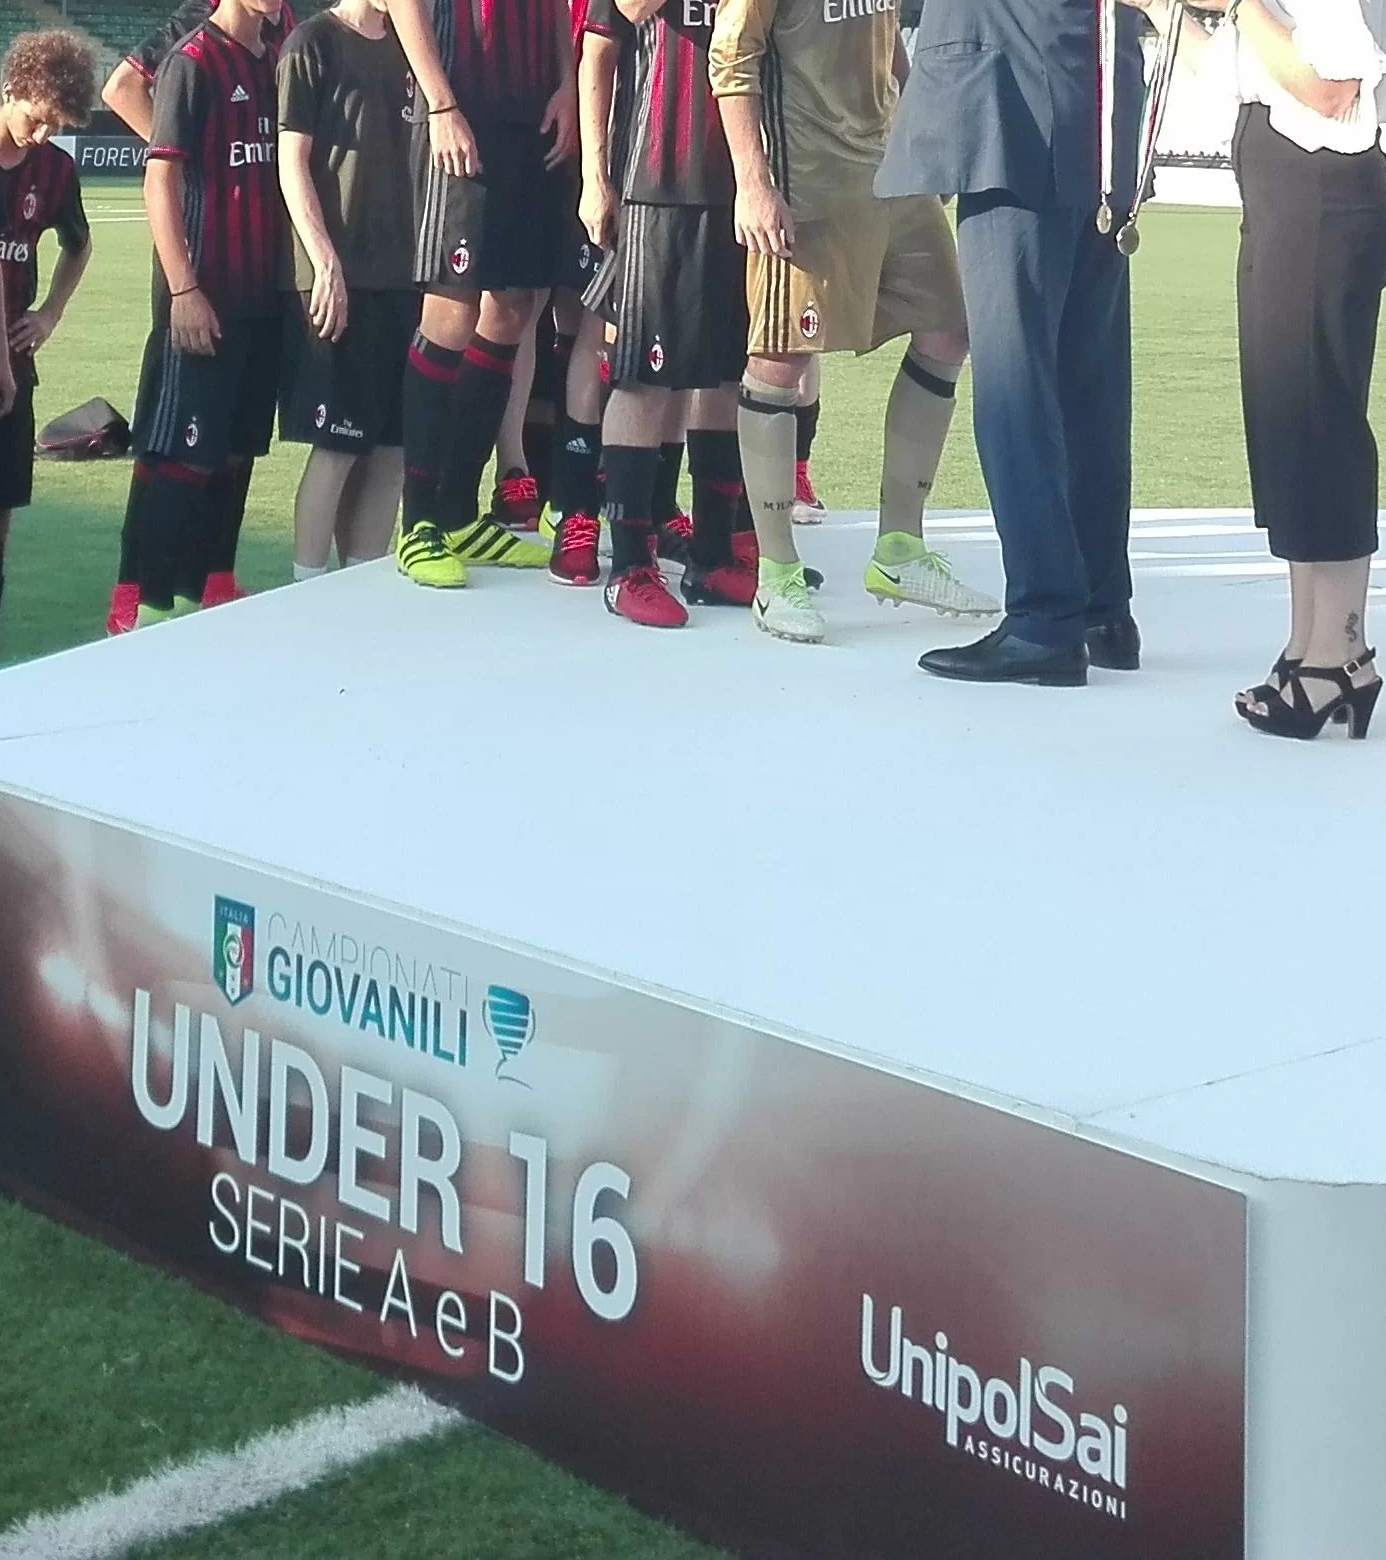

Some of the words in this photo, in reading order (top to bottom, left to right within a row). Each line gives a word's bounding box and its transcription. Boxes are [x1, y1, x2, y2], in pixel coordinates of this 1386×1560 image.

[81, 146, 150, 168] FOREVE
[219, 904, 250, 925] ITALIA
[268, 912, 469, 1007] CAMPIONATI
[267, 945, 468, 1068] GIOVANILI
[131, 988, 464, 1255] UNDER
[509, 1130, 639, 1321] 16
[208, 1171, 364, 1313] SERIE
[379, 1248, 417, 1338] A
[435, 1290, 468, 1358] e
[488, 1290, 526, 1384] B
[861, 1293, 1128, 1489] UnipolSai
[963, 1435, 1127, 1520] ASSICURAZIONI
